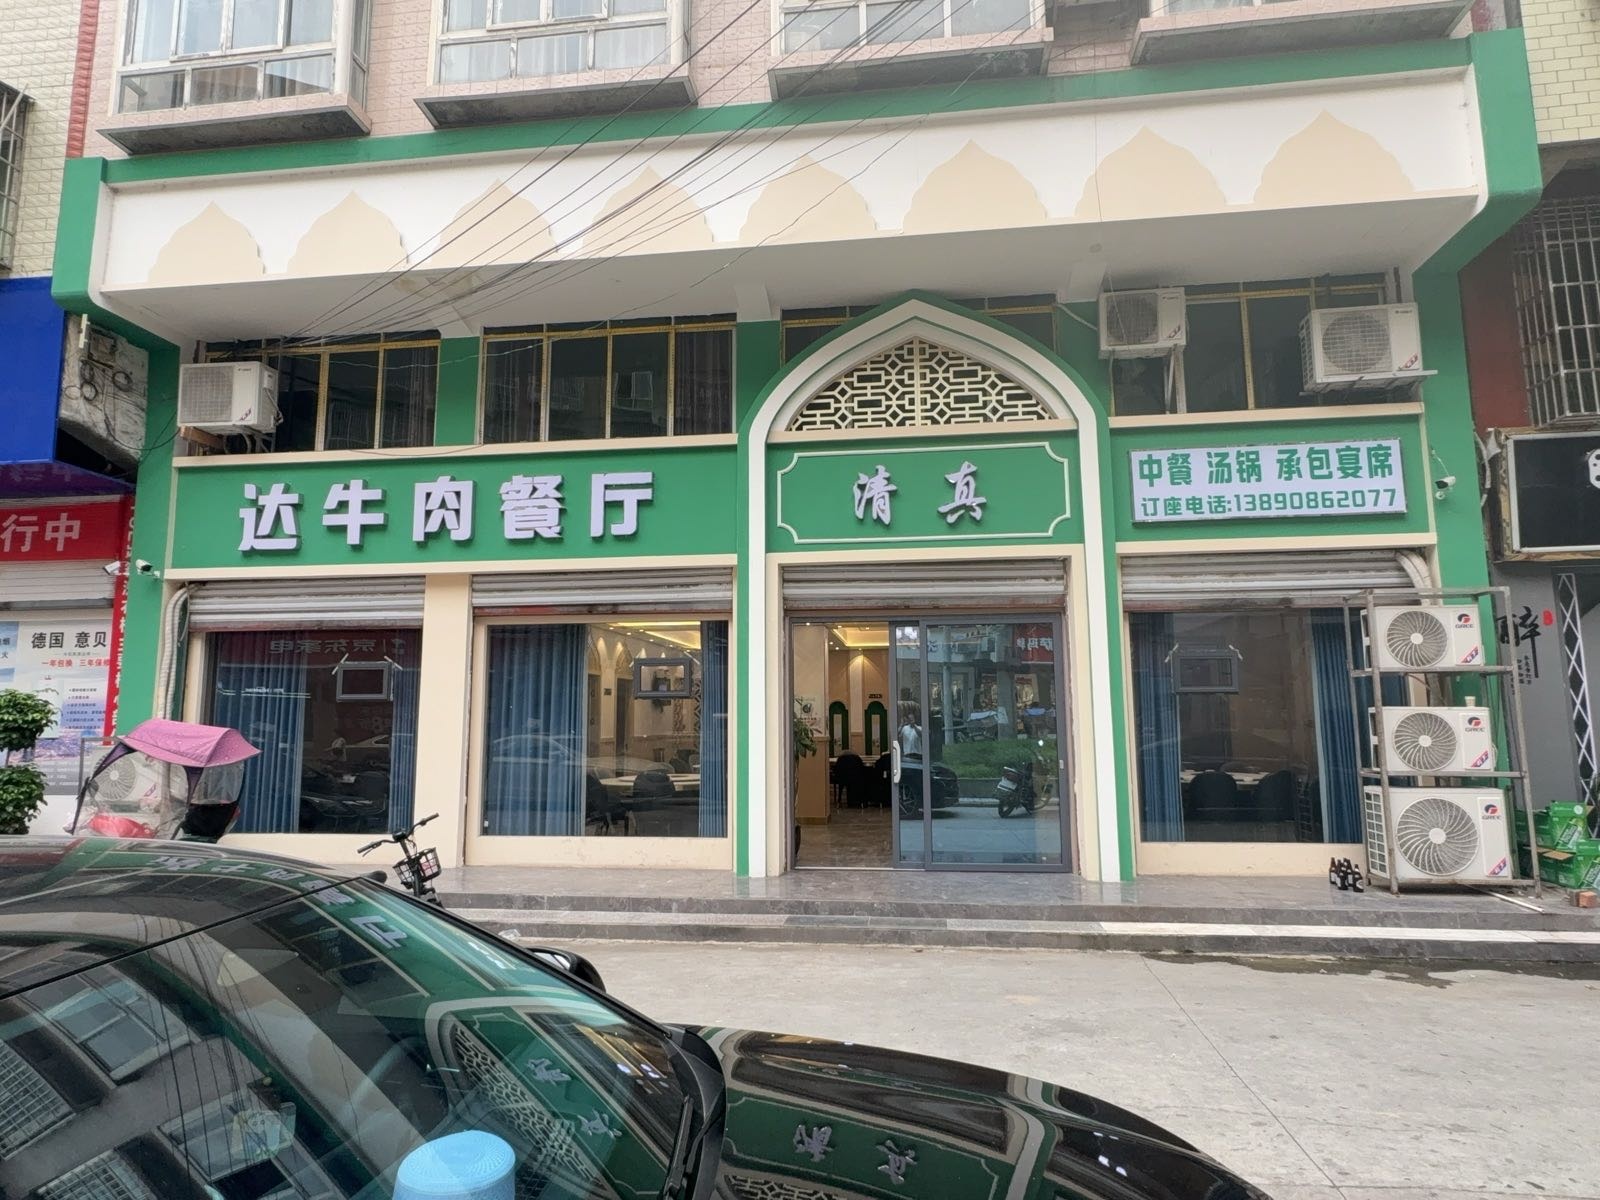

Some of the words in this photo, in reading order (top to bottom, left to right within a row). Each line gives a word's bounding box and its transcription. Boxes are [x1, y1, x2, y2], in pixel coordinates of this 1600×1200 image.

[1138, 452, 1193, 487] 中餐
[1206, 449, 1262, 484] 汤锅
[1276, 443, 1394, 481] 承包宴席
[238, 471, 654, 552] 达牛肉餐厅
[852, 461, 987, 525] 清真
[1141, 488, 1397, 517] 订座电话:13890862077
[31, 631, 64, 649] 德国
[75, 630, 107, 648] 意贝
